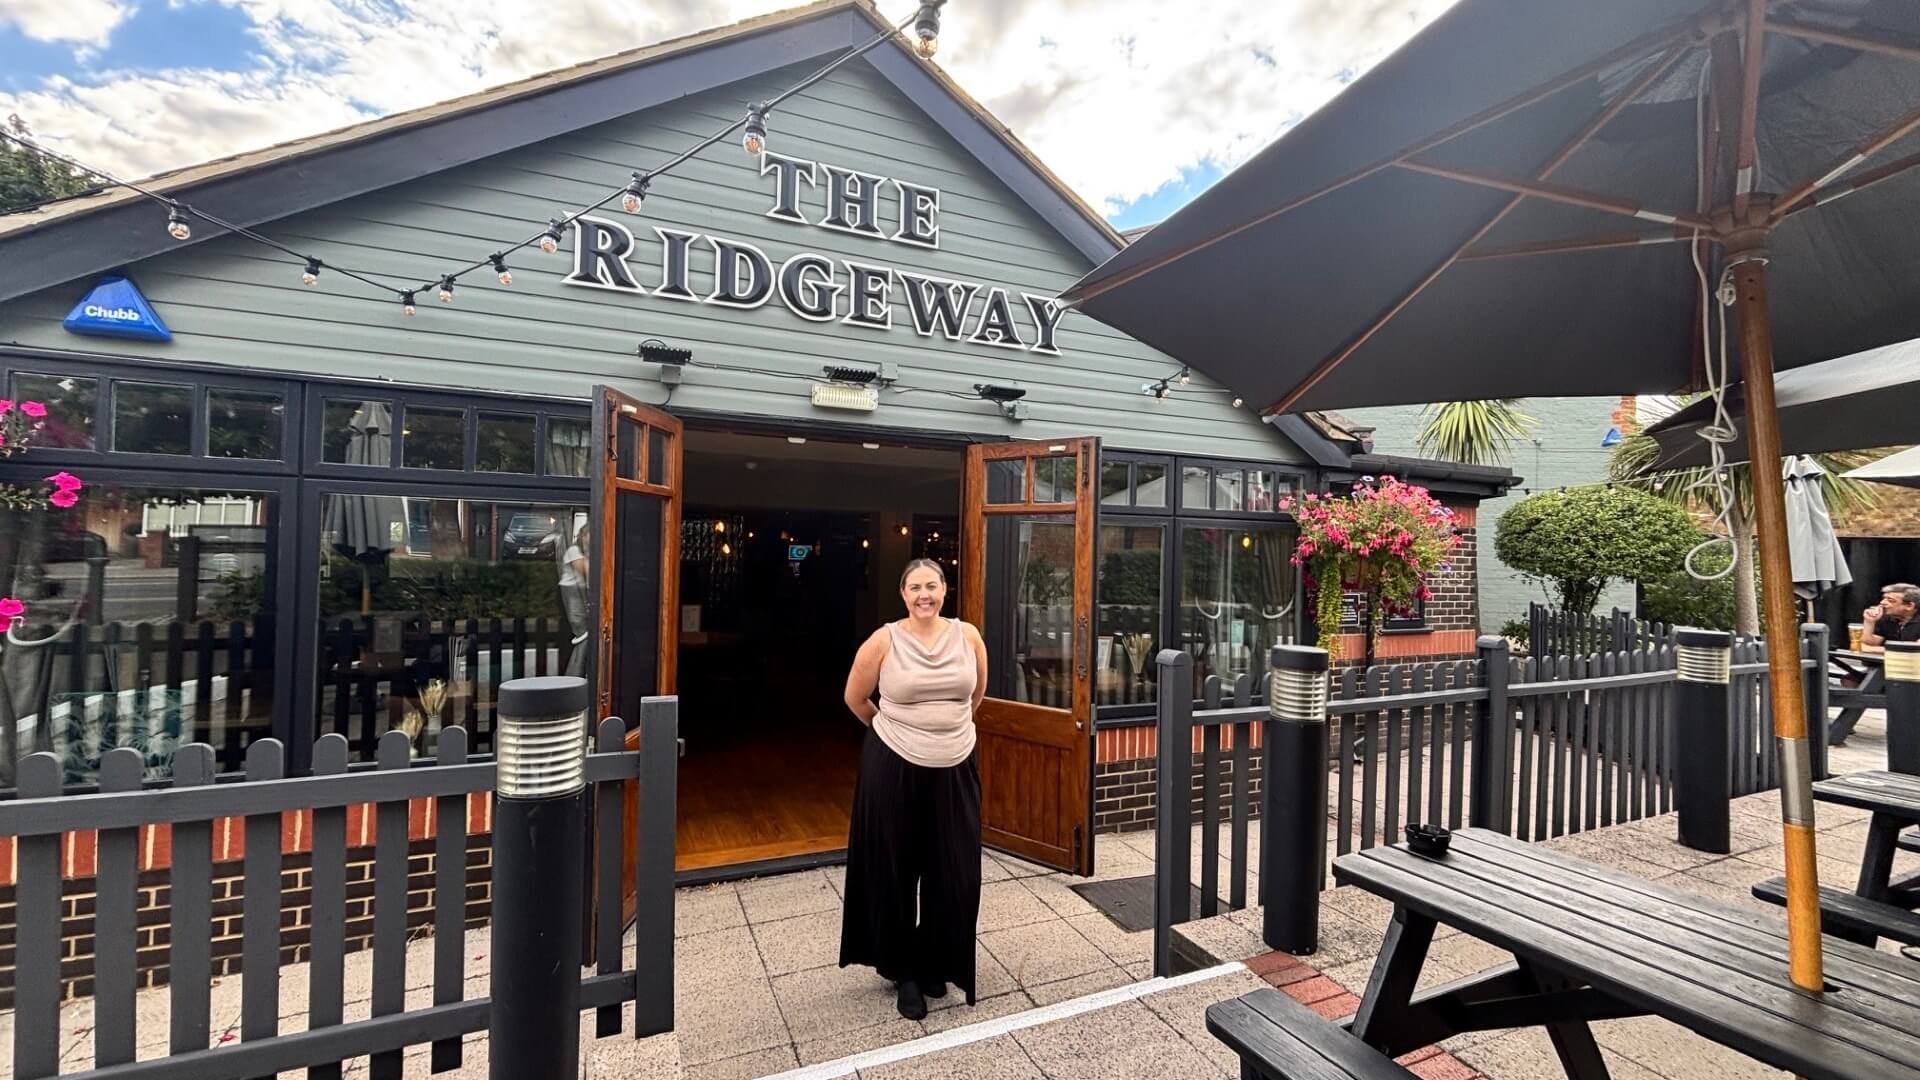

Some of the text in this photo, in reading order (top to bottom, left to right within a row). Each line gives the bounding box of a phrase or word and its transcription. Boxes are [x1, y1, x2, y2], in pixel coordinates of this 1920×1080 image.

[760, 151, 940, 249] THE
[84, 305, 140, 321] Chubb
[561, 210, 1066, 356] RIDGEWAY
